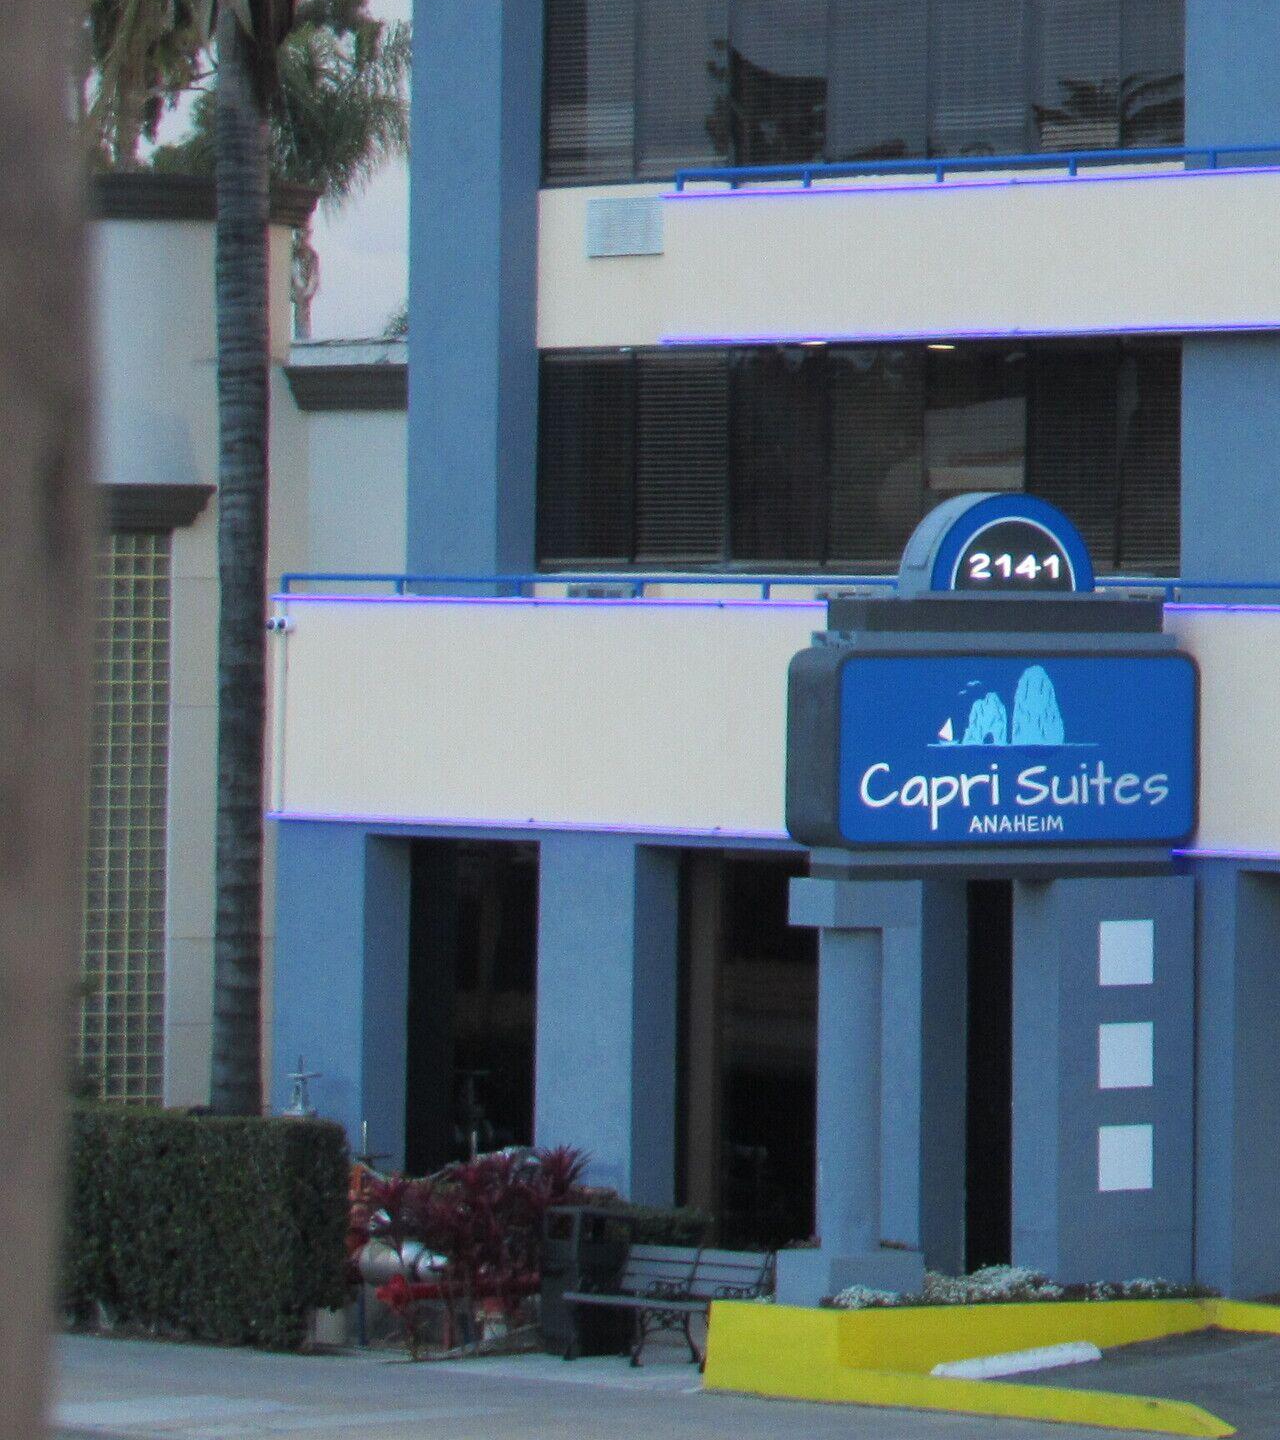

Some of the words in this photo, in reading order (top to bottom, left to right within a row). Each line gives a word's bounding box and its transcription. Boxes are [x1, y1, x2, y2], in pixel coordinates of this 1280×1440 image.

[969, 552, 1061, 580] 2141
[860, 762, 999, 831] Capri
[1016, 760, 1169, 806] Suites
[969, 815, 1064, 833] ANAHEIM
